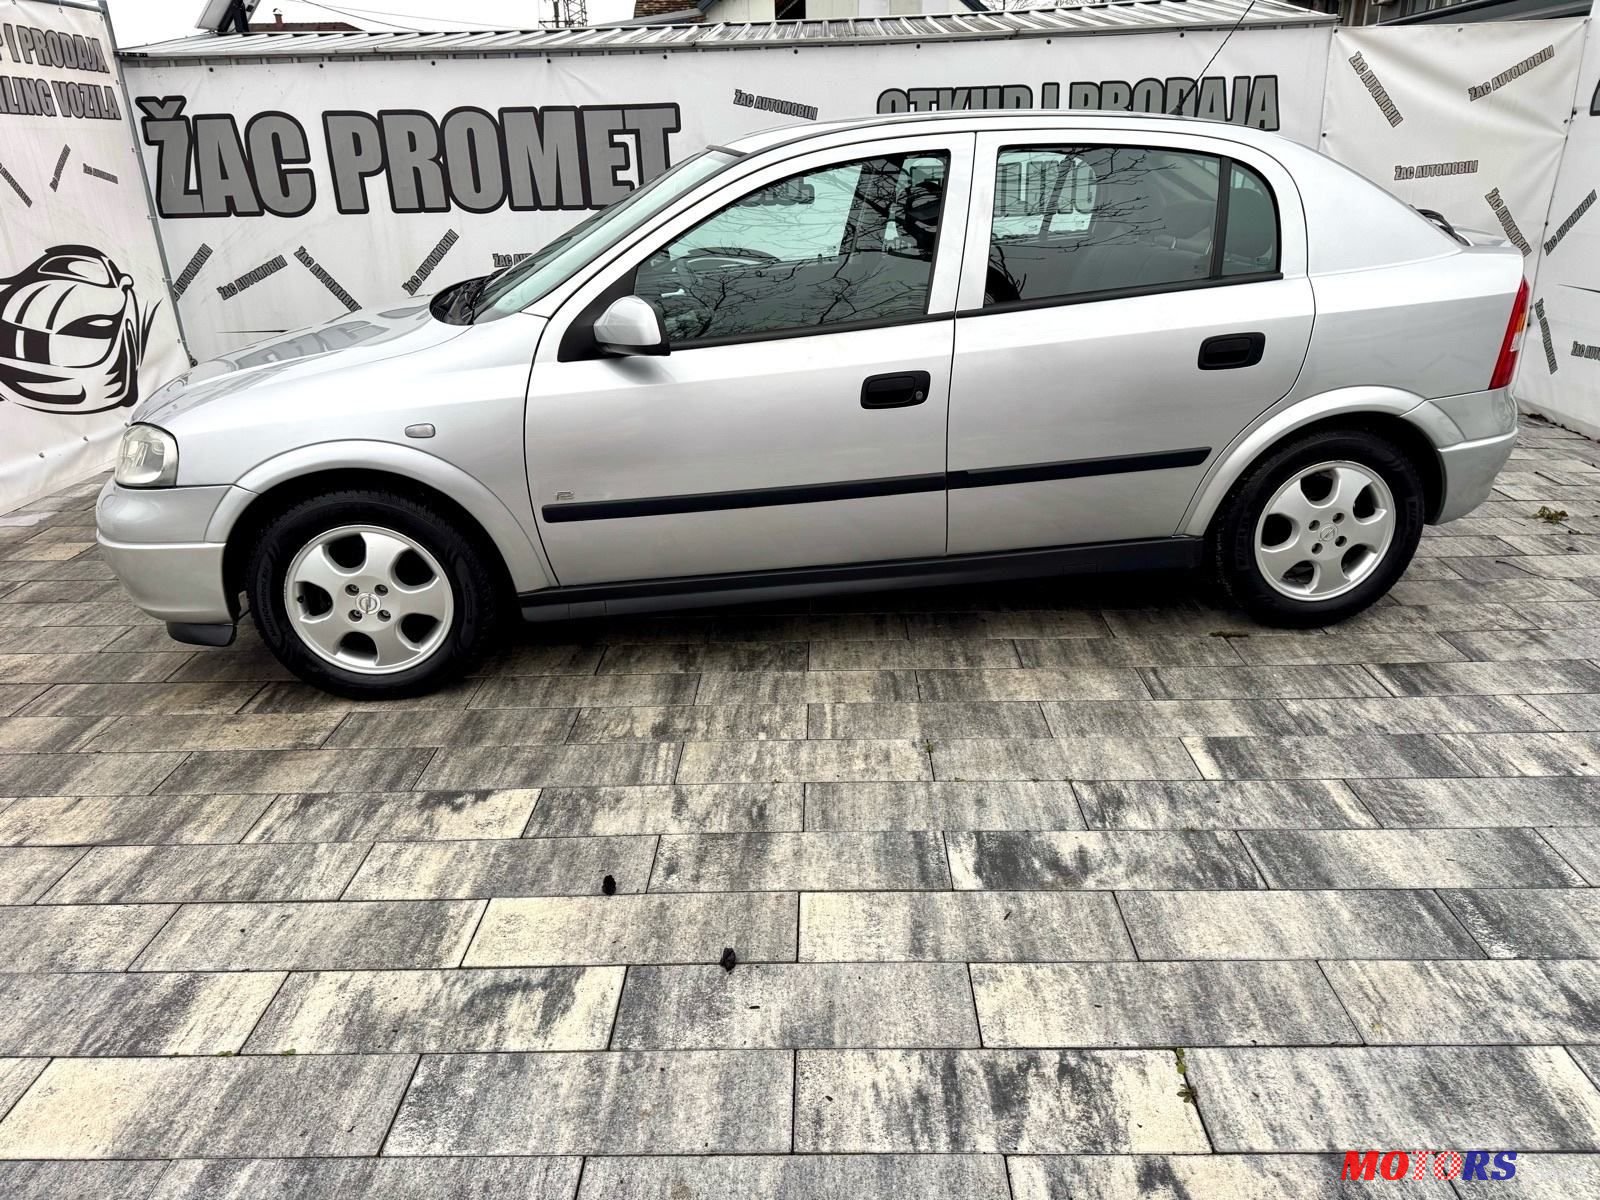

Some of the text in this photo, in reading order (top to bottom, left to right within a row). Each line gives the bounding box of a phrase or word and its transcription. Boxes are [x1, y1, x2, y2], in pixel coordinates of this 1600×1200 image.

[3, 23, 110, 74] I PRODAJA
[1348, 51, 1404, 128] ŽAC AUTOMOBILI
[1467, 44, 1555, 102] ŽAC AUTOMOBILI
[51, 80, 122, 121] VOZILA
[733, 88, 818, 121] ŽAC AUTOMOBILI
[134, 95, 316, 219] ŽAC
[321, 102, 682, 216] PROMET
[1394, 160, 1479, 181] ŽAC AUTOMOBILI
[1484, 186, 1504, 211] ŽAC
[176, 243, 213, 295] AUTOMOBILI
[216, 282, 238, 301] ŽAC
[234, 254, 288, 292] AUTOMOBILI
[293, 245, 315, 268] ŽAC
[401, 228, 460, 297] ŽAC AUTOMOBILI
[492, 253, 513, 268] ŽAC
